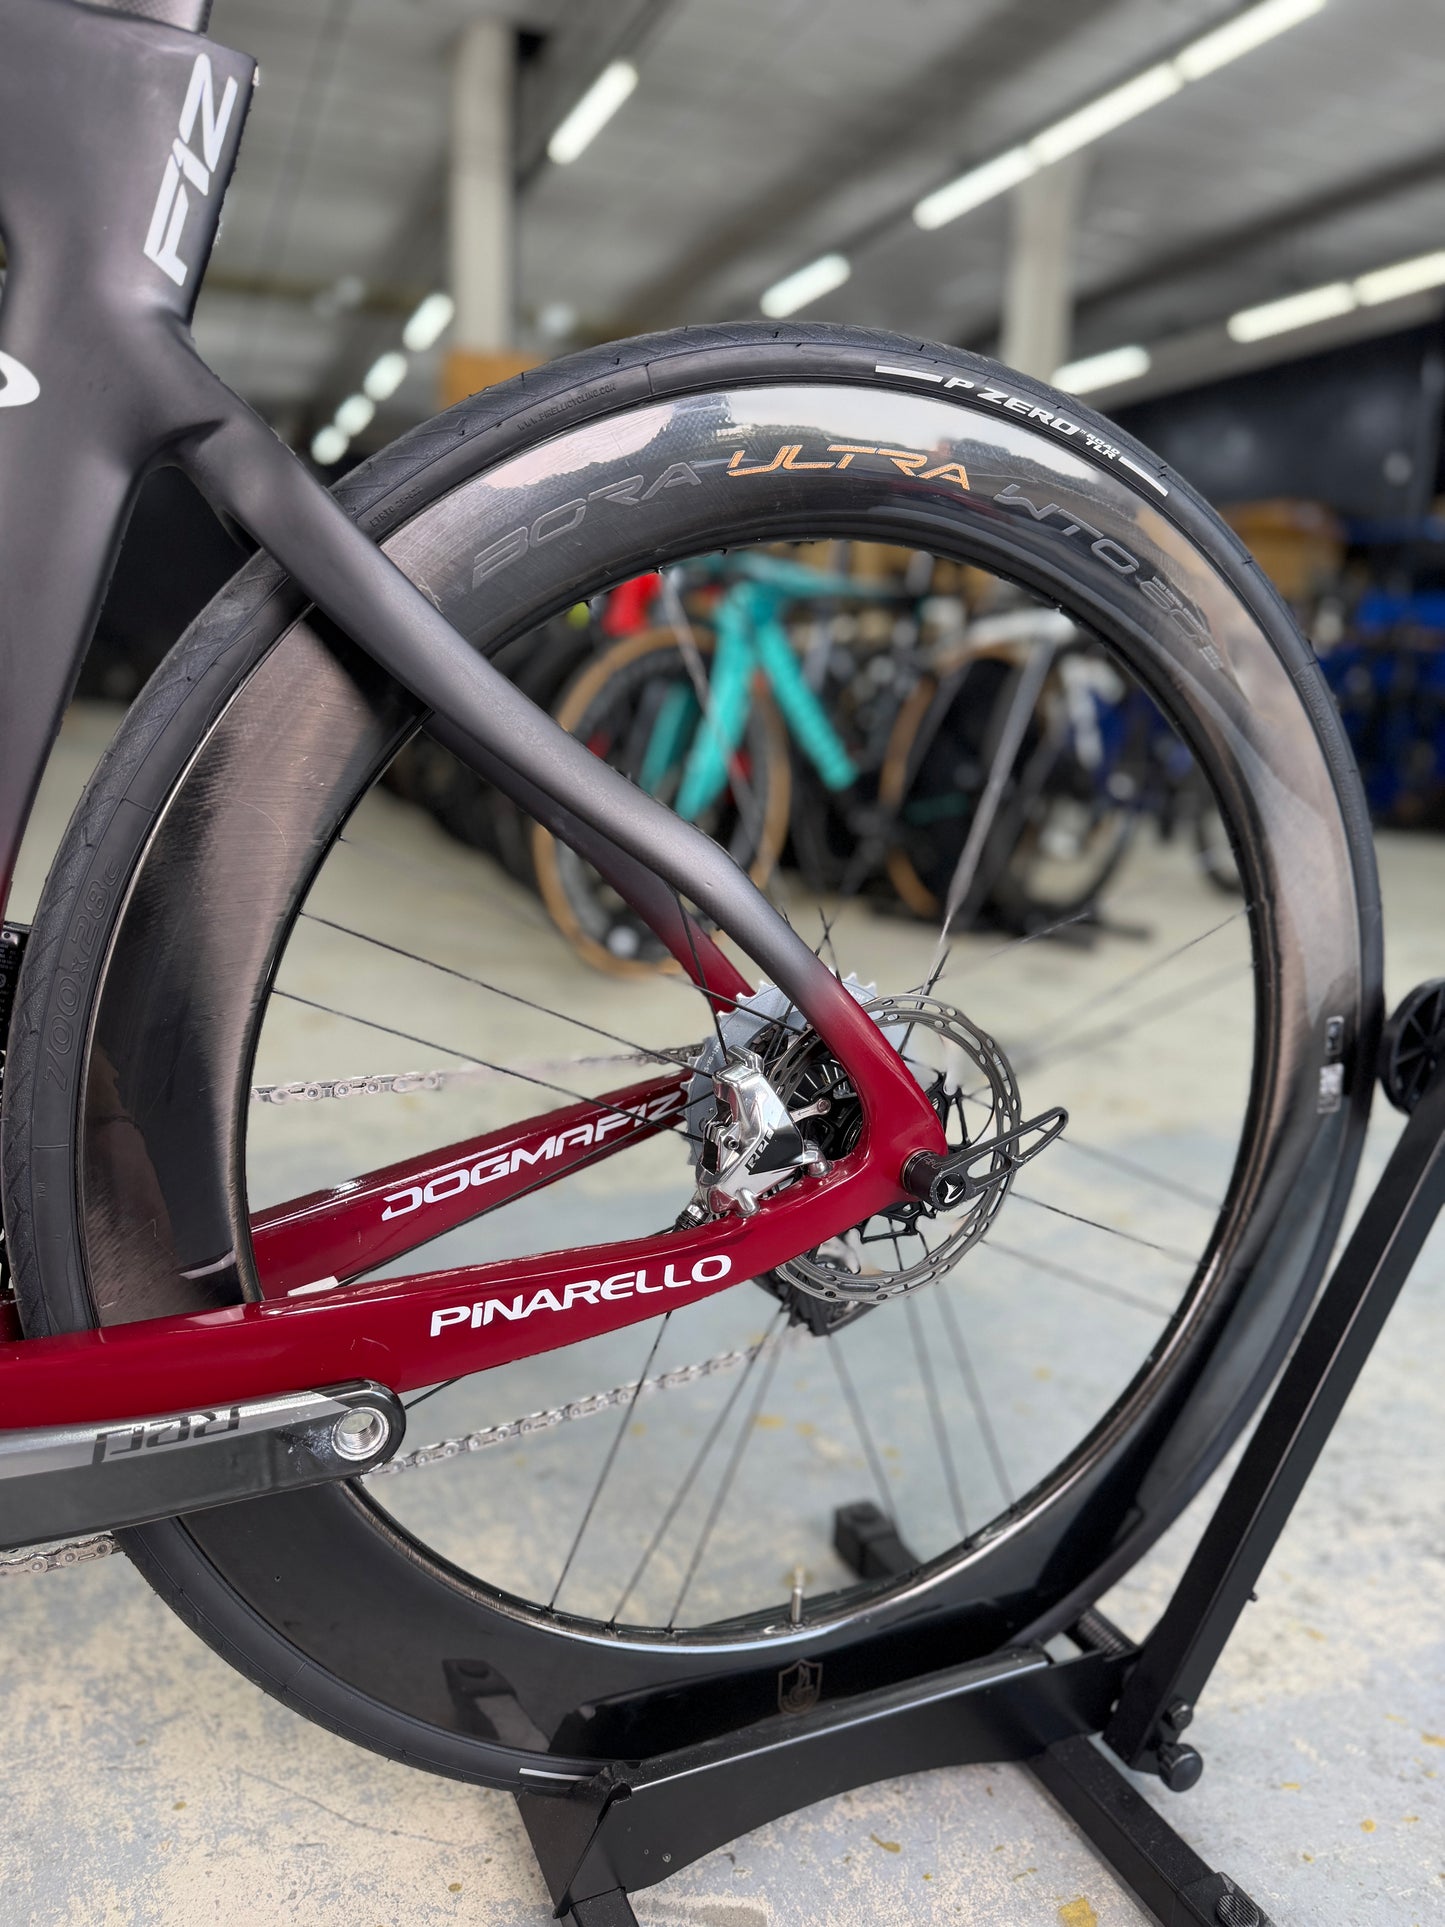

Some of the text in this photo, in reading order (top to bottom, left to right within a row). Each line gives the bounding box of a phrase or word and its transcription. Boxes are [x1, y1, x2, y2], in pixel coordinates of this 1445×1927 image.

[943, 377, 975, 391] P
[1086, 439, 1116, 460] TLR
[472, 462, 702, 592] BORA
[727, 444, 970, 491] ULTRA
[994, 484, 1140, 576] WTO
[430, 1254, 733, 1337] PINARELLO
